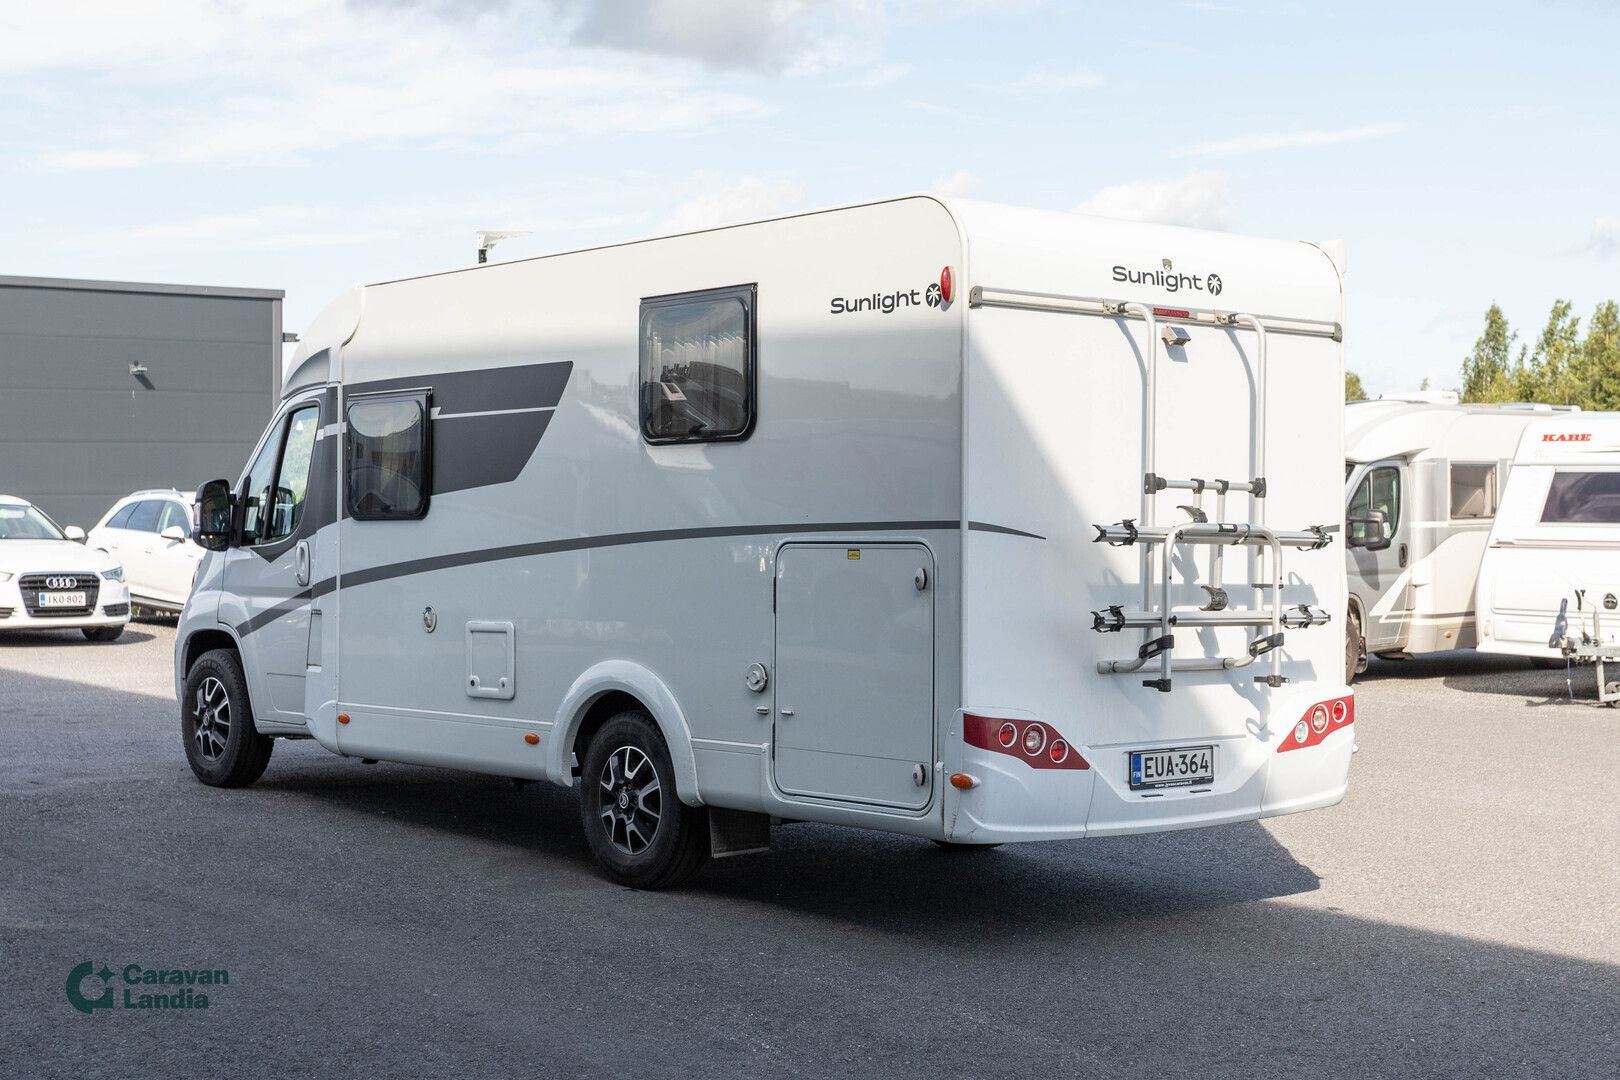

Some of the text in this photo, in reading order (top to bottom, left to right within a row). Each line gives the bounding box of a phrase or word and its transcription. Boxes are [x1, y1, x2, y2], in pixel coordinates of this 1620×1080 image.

[1112, 265, 1203, 292] Sunlight
[830, 289, 920, 314] Sunlight
[1541, 433, 1592, 442] KABE
[1144, 752, 1209, 778] EUA-364
